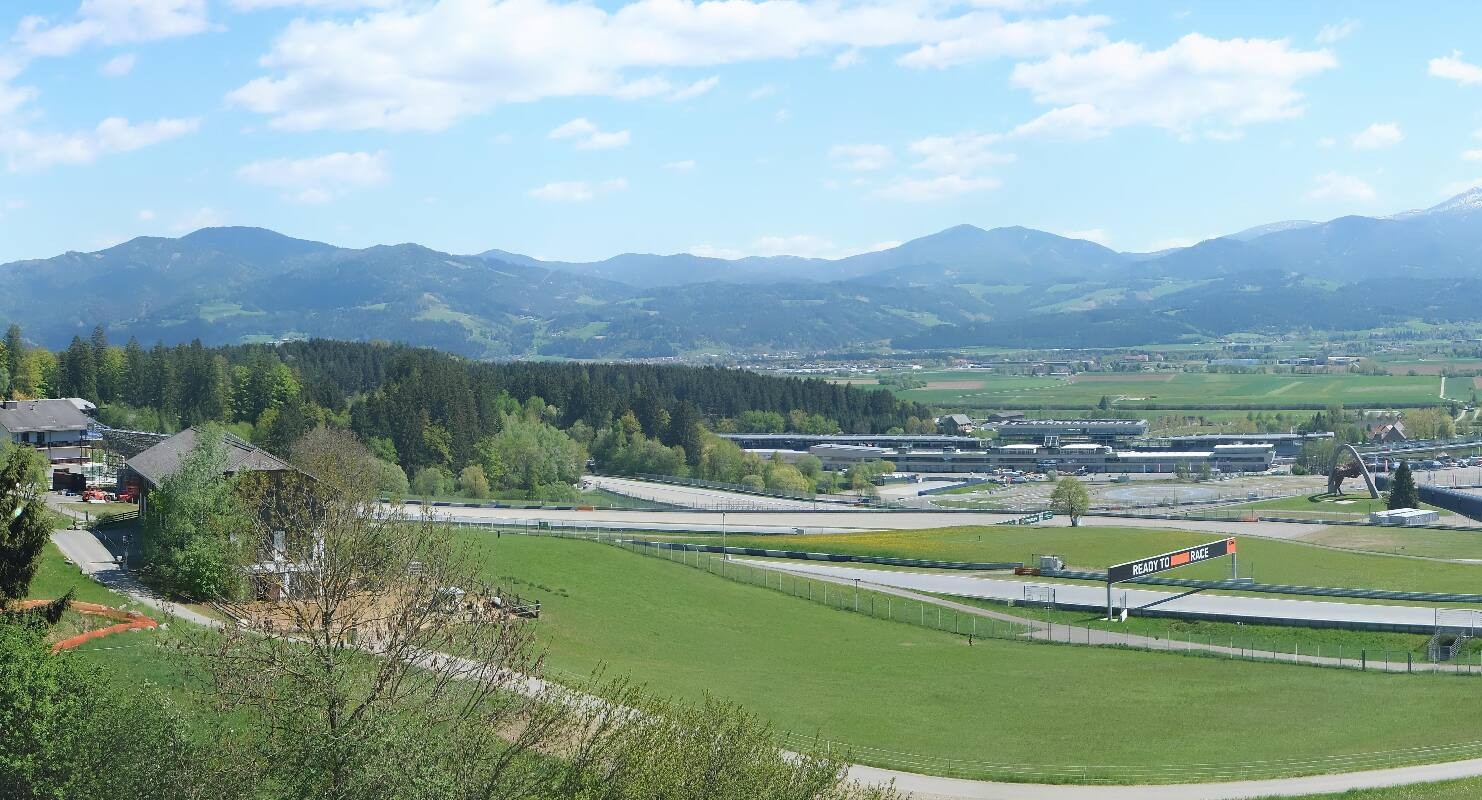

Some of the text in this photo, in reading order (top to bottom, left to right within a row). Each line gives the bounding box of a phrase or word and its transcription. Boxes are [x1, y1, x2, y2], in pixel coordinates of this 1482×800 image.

[1132, 547, 1209, 576] READY TO RACE
